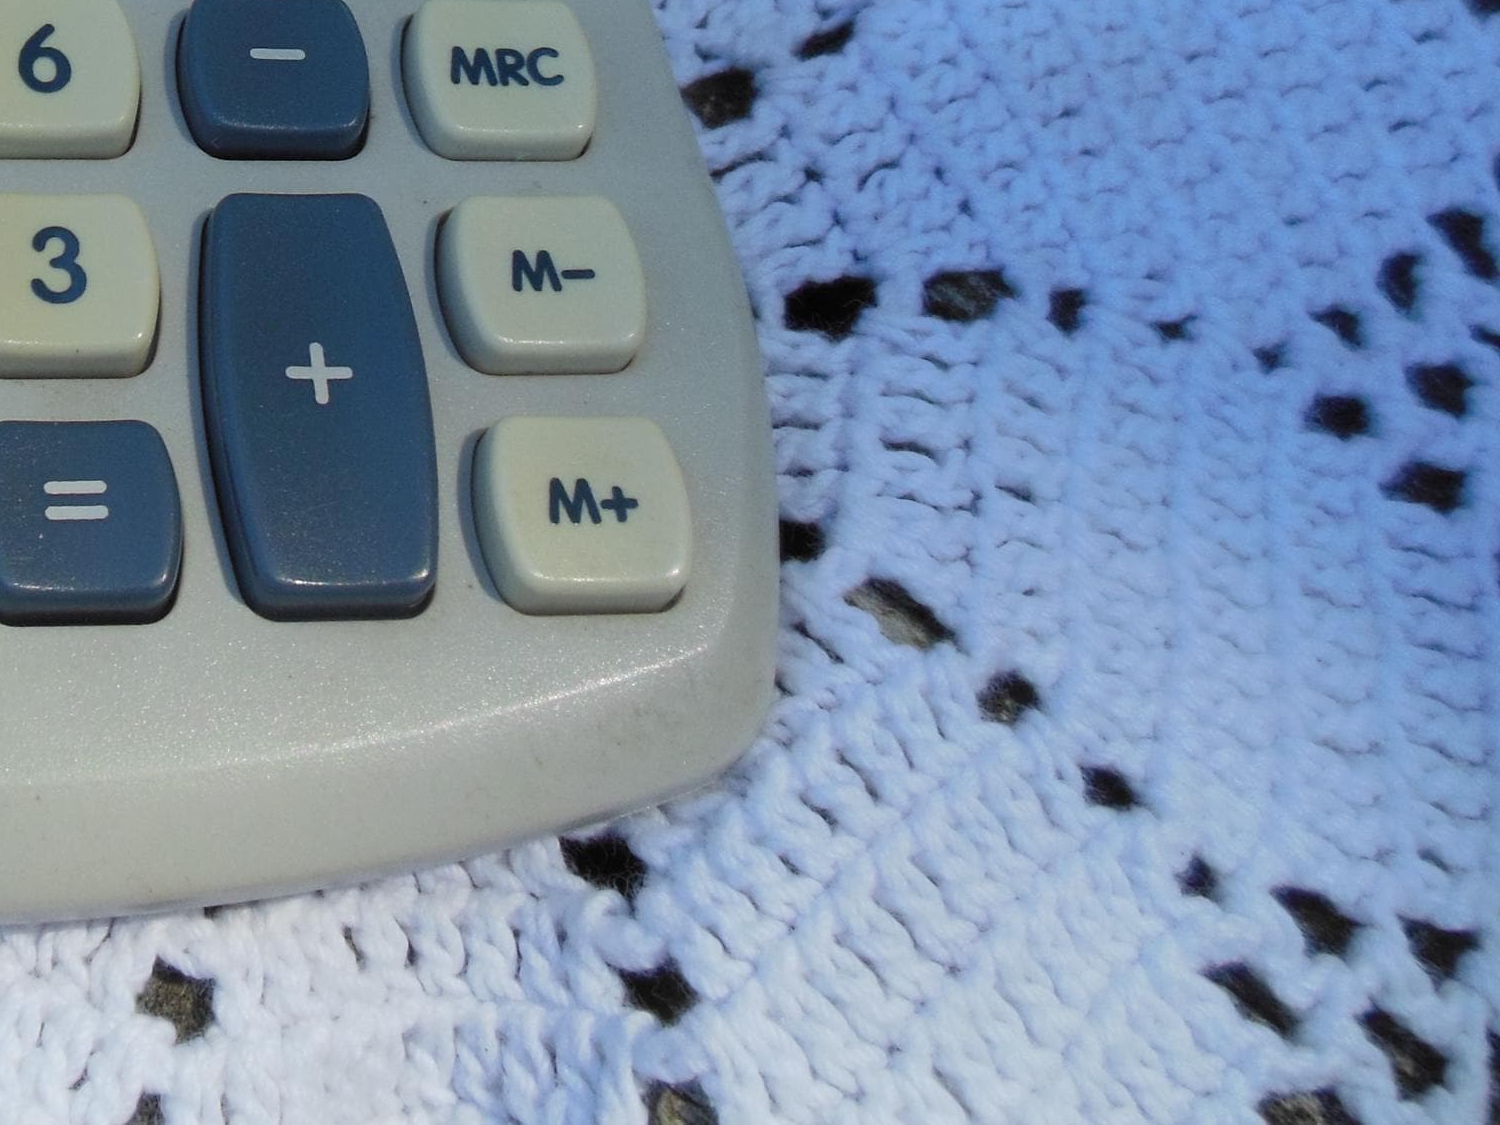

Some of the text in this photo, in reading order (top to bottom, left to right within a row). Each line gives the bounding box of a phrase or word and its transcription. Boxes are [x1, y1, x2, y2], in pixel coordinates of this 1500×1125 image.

[18, 24, 72, 94] 6
[451, 46, 565, 87] MRC
[31, 226, 88, 305] 3
[549, 478, 639, 525] M+
